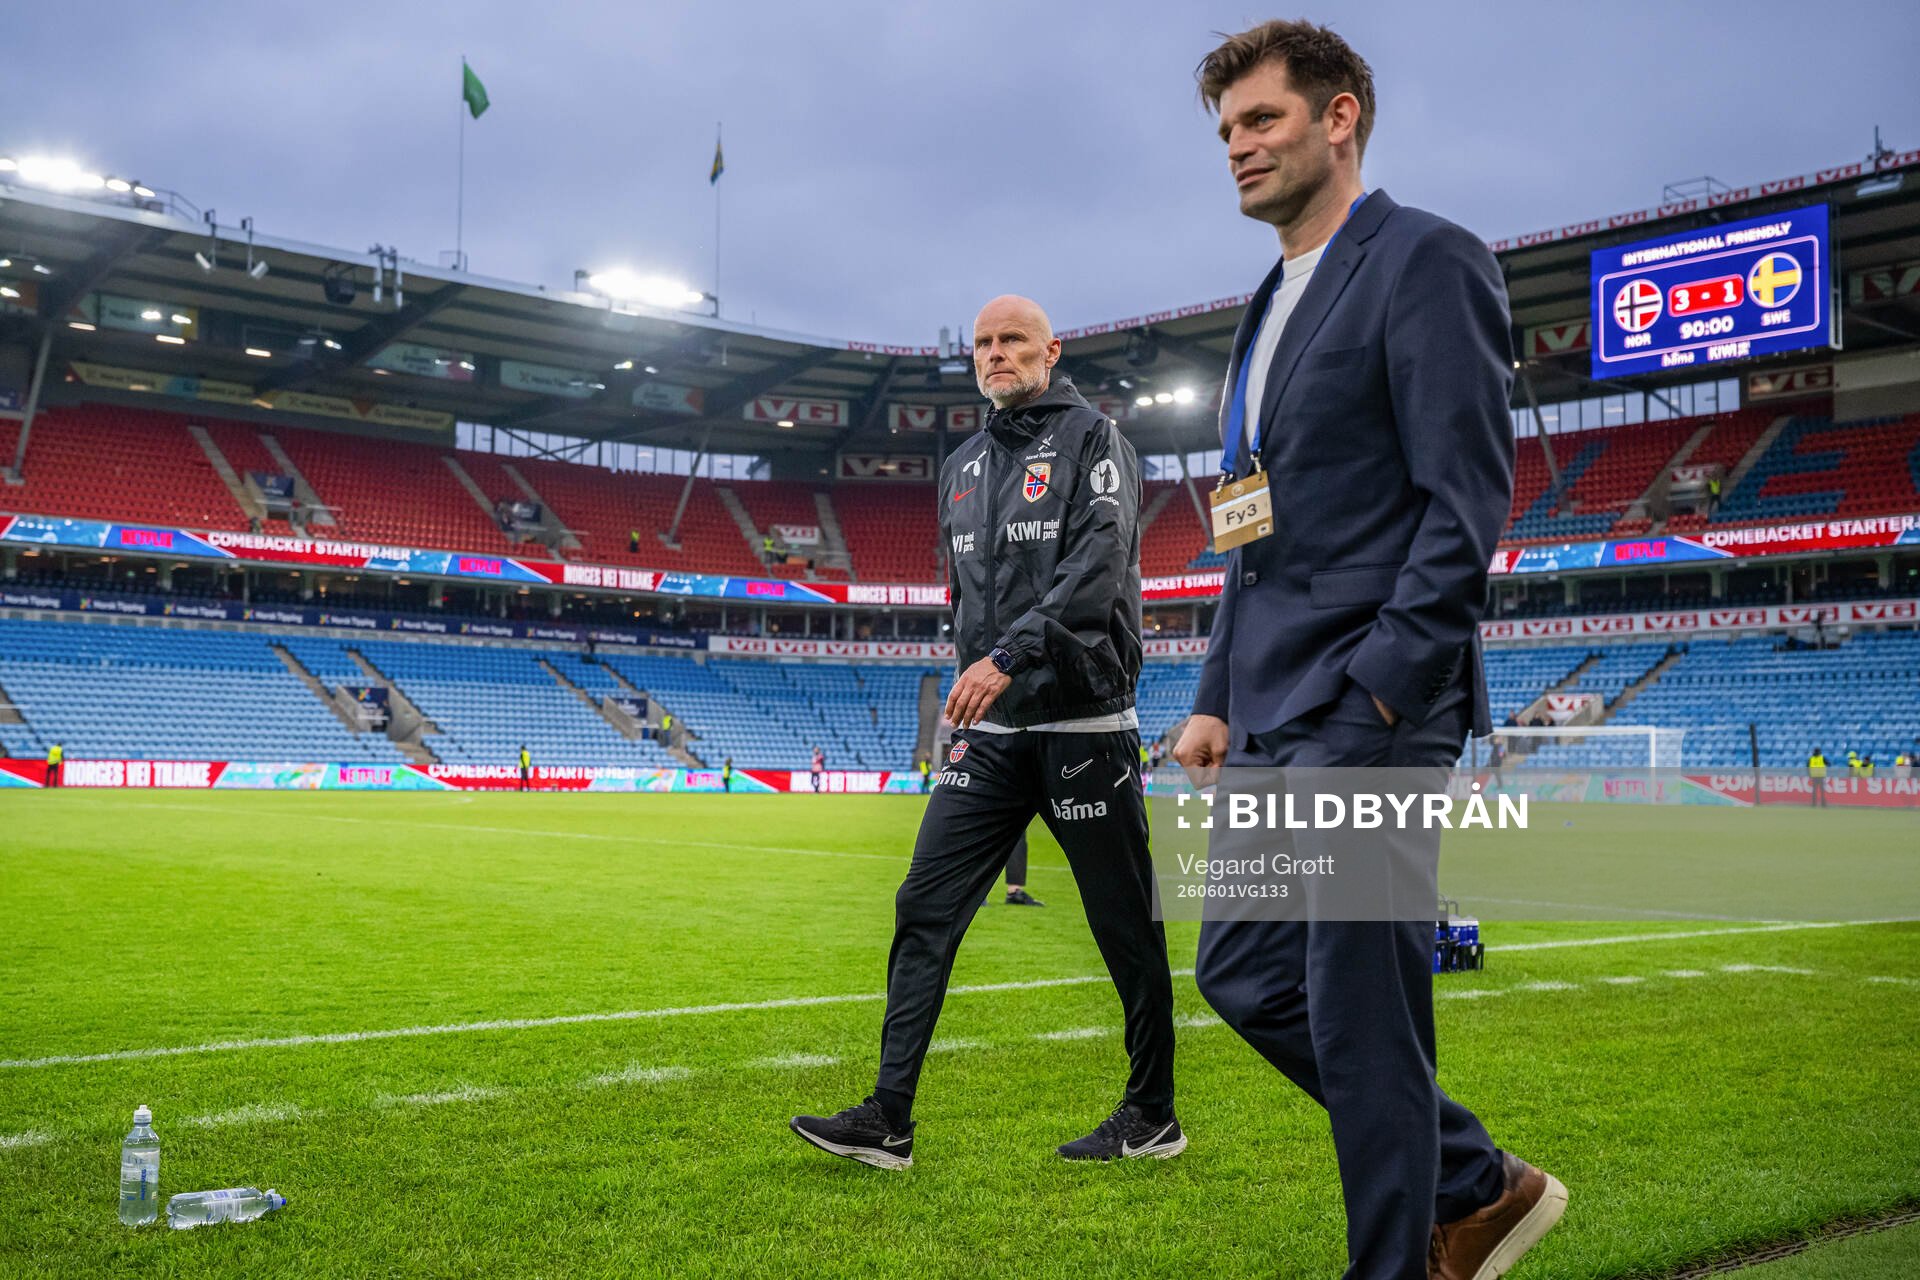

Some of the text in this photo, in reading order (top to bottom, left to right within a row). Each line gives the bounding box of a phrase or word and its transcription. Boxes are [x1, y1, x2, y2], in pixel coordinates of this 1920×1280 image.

[1622, 221, 1793, 267] INTERNATIONAL FRIENDLY
[1674, 288, 1690, 312] 3
[1722, 281, 1738, 303] 1
[1761, 309, 1791, 326] SWE
[1679, 315, 1735, 340] 90:00
[1535, 321, 1587, 352] V
[1624, 332, 1652, 348] NOR
[754, 400, 840, 425] VG
[842, 457, 928, 478] VG
[1226, 503, 1258, 525] Fy3
[1007, 521, 1041, 543] KIWI
[1044, 519, 1060, 530] mini
[1703, 515, 1920, 548] COMEBACKET STARTER-
[208, 532, 312, 554] COMEBACKET
[1043, 530, 1058, 541] pris
[1141, 575, 1182, 592] BACKET
[1710, 610, 1766, 627] VG
[1779, 607, 1839, 624] VG
[1852, 602, 1916, 620] VG
[1523, 620, 1572, 636] VG
[1583, 617, 1633, 634] VG
[1645, 614, 1698, 631] VG
[728, 640, 767, 652] VG
[775, 641, 817, 654] VG
[826, 642, 868, 655] VG
[878, 643, 921, 657] VG
[63, 762, 124, 787] NORGES
[126, 762, 150, 787] VEI
[338, 767, 391, 784] NETFLIX
[1604, 780, 1664, 798] NETFLX
